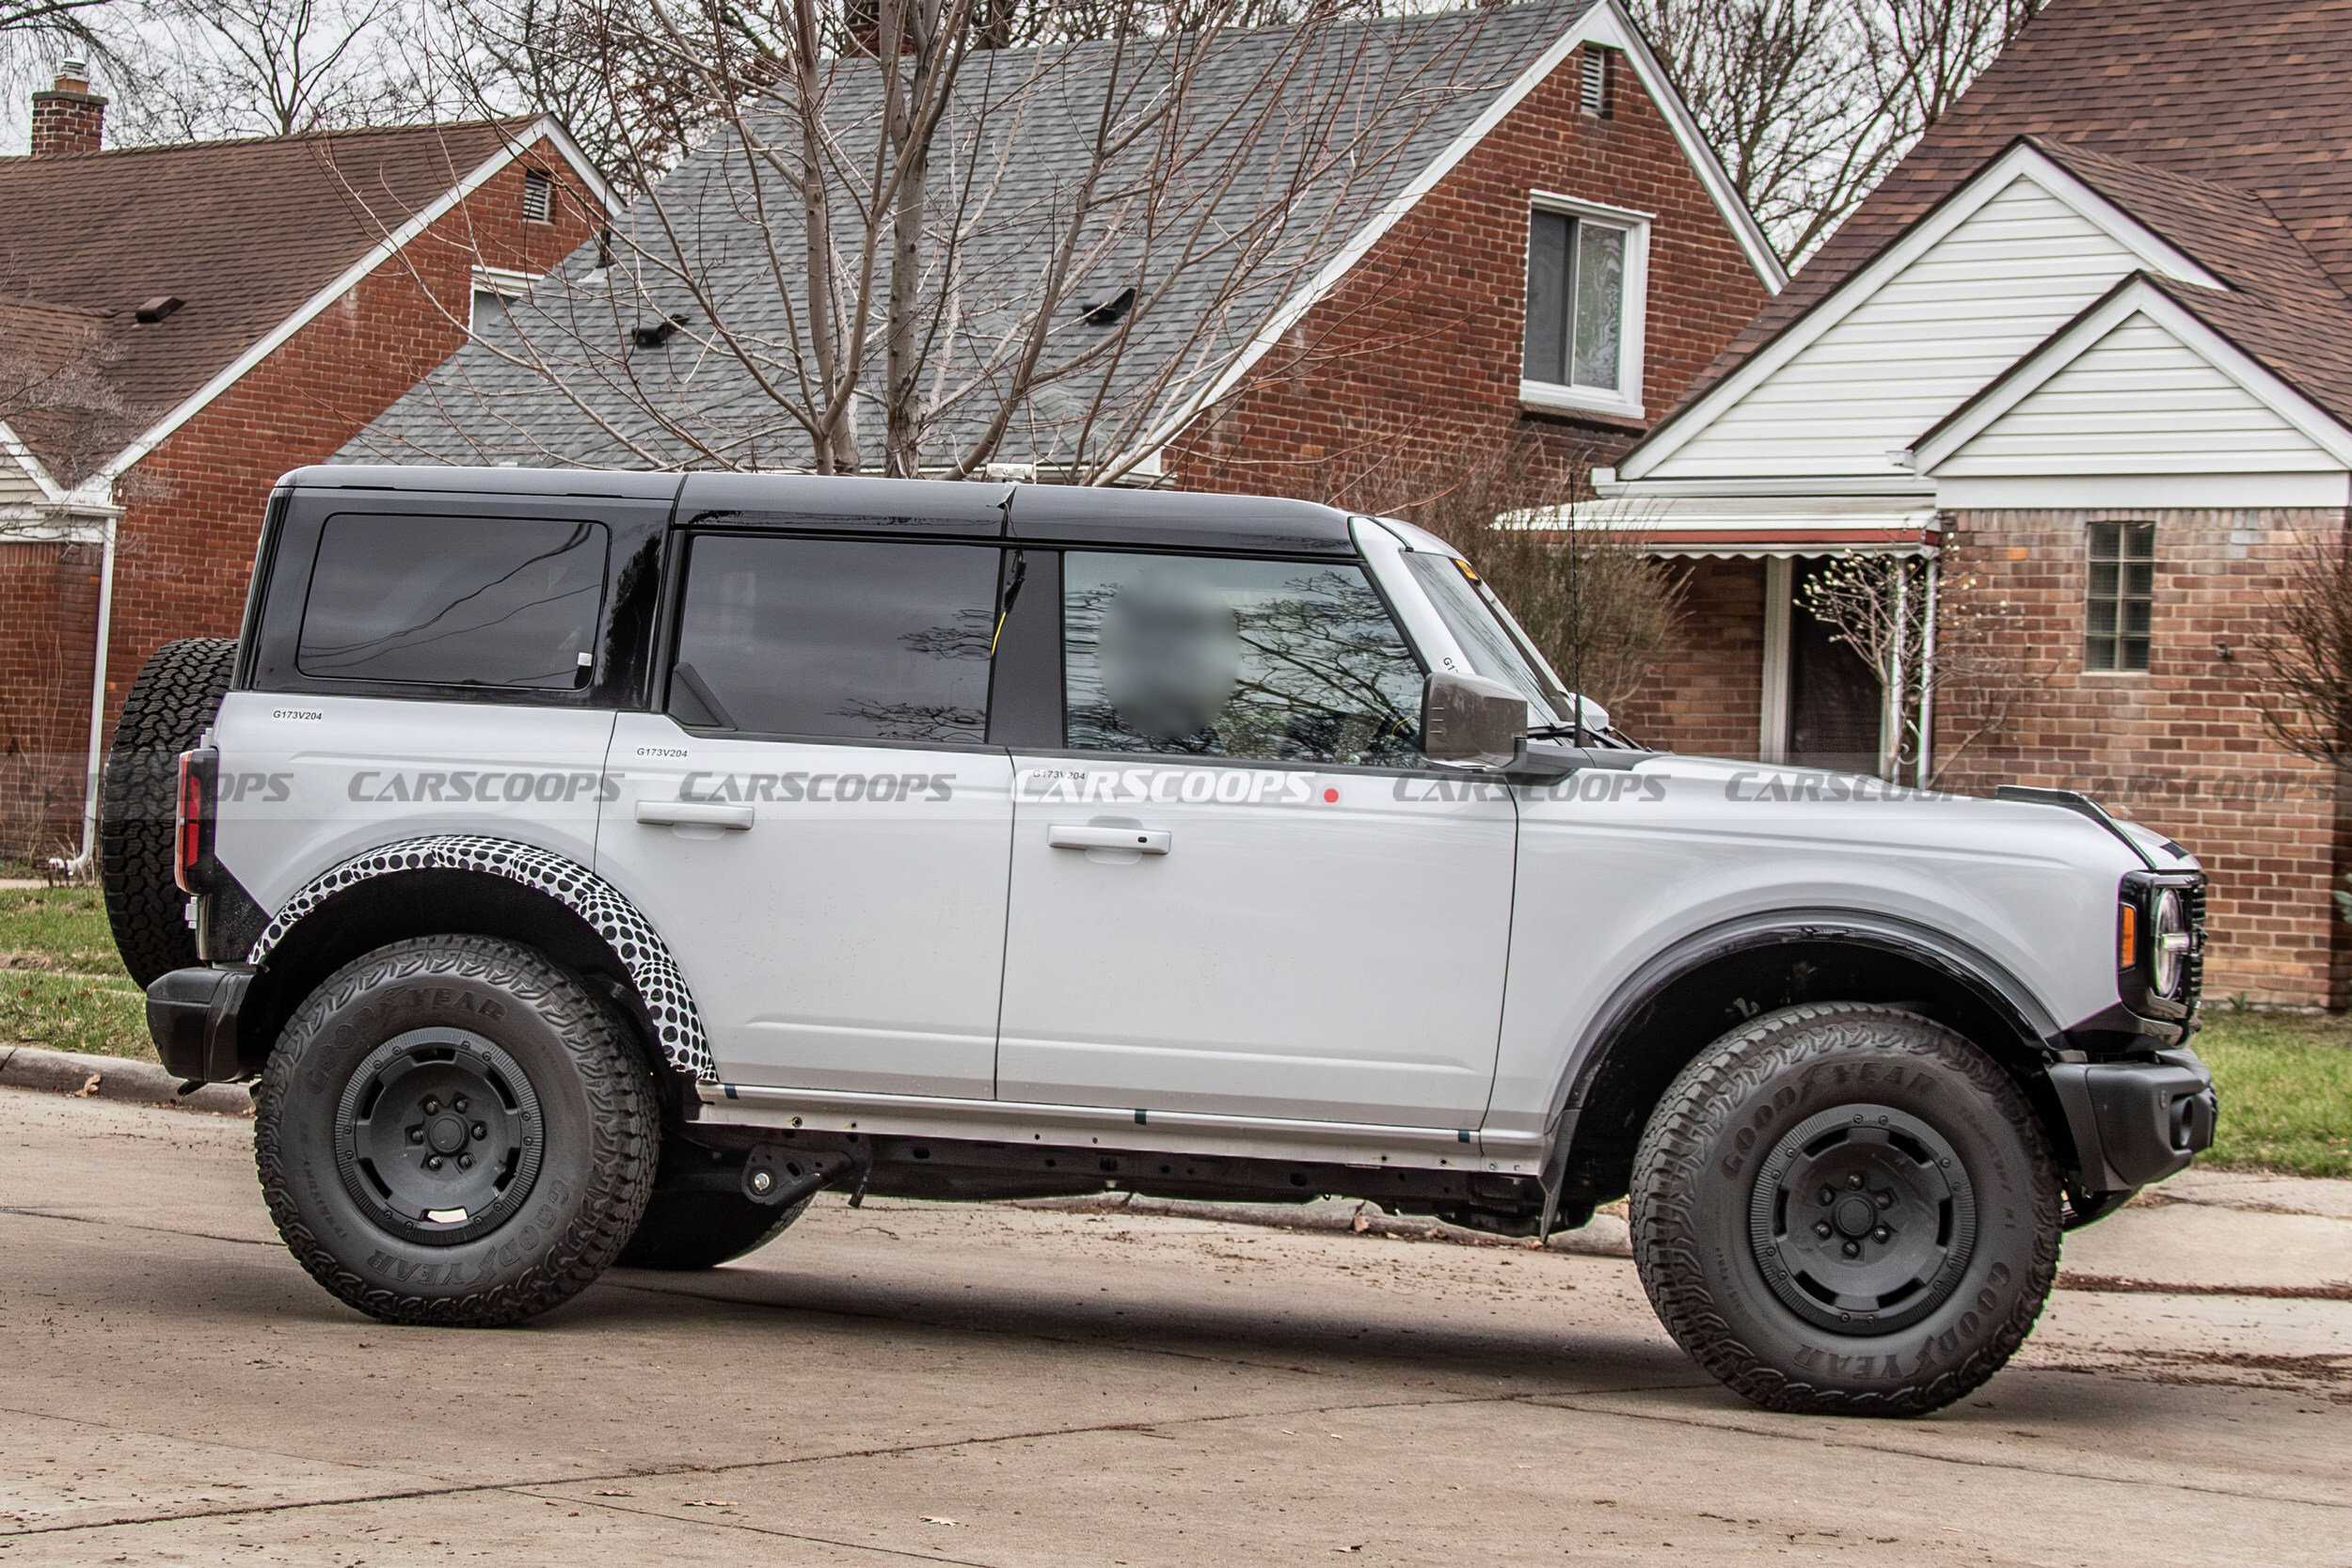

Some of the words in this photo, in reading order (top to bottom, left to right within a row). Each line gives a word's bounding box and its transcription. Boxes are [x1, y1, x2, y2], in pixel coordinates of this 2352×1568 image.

[1442, 657, 1459, 673] G1
[273, 710, 323, 721] G173V204
[636, 747, 688, 758] G173V204
